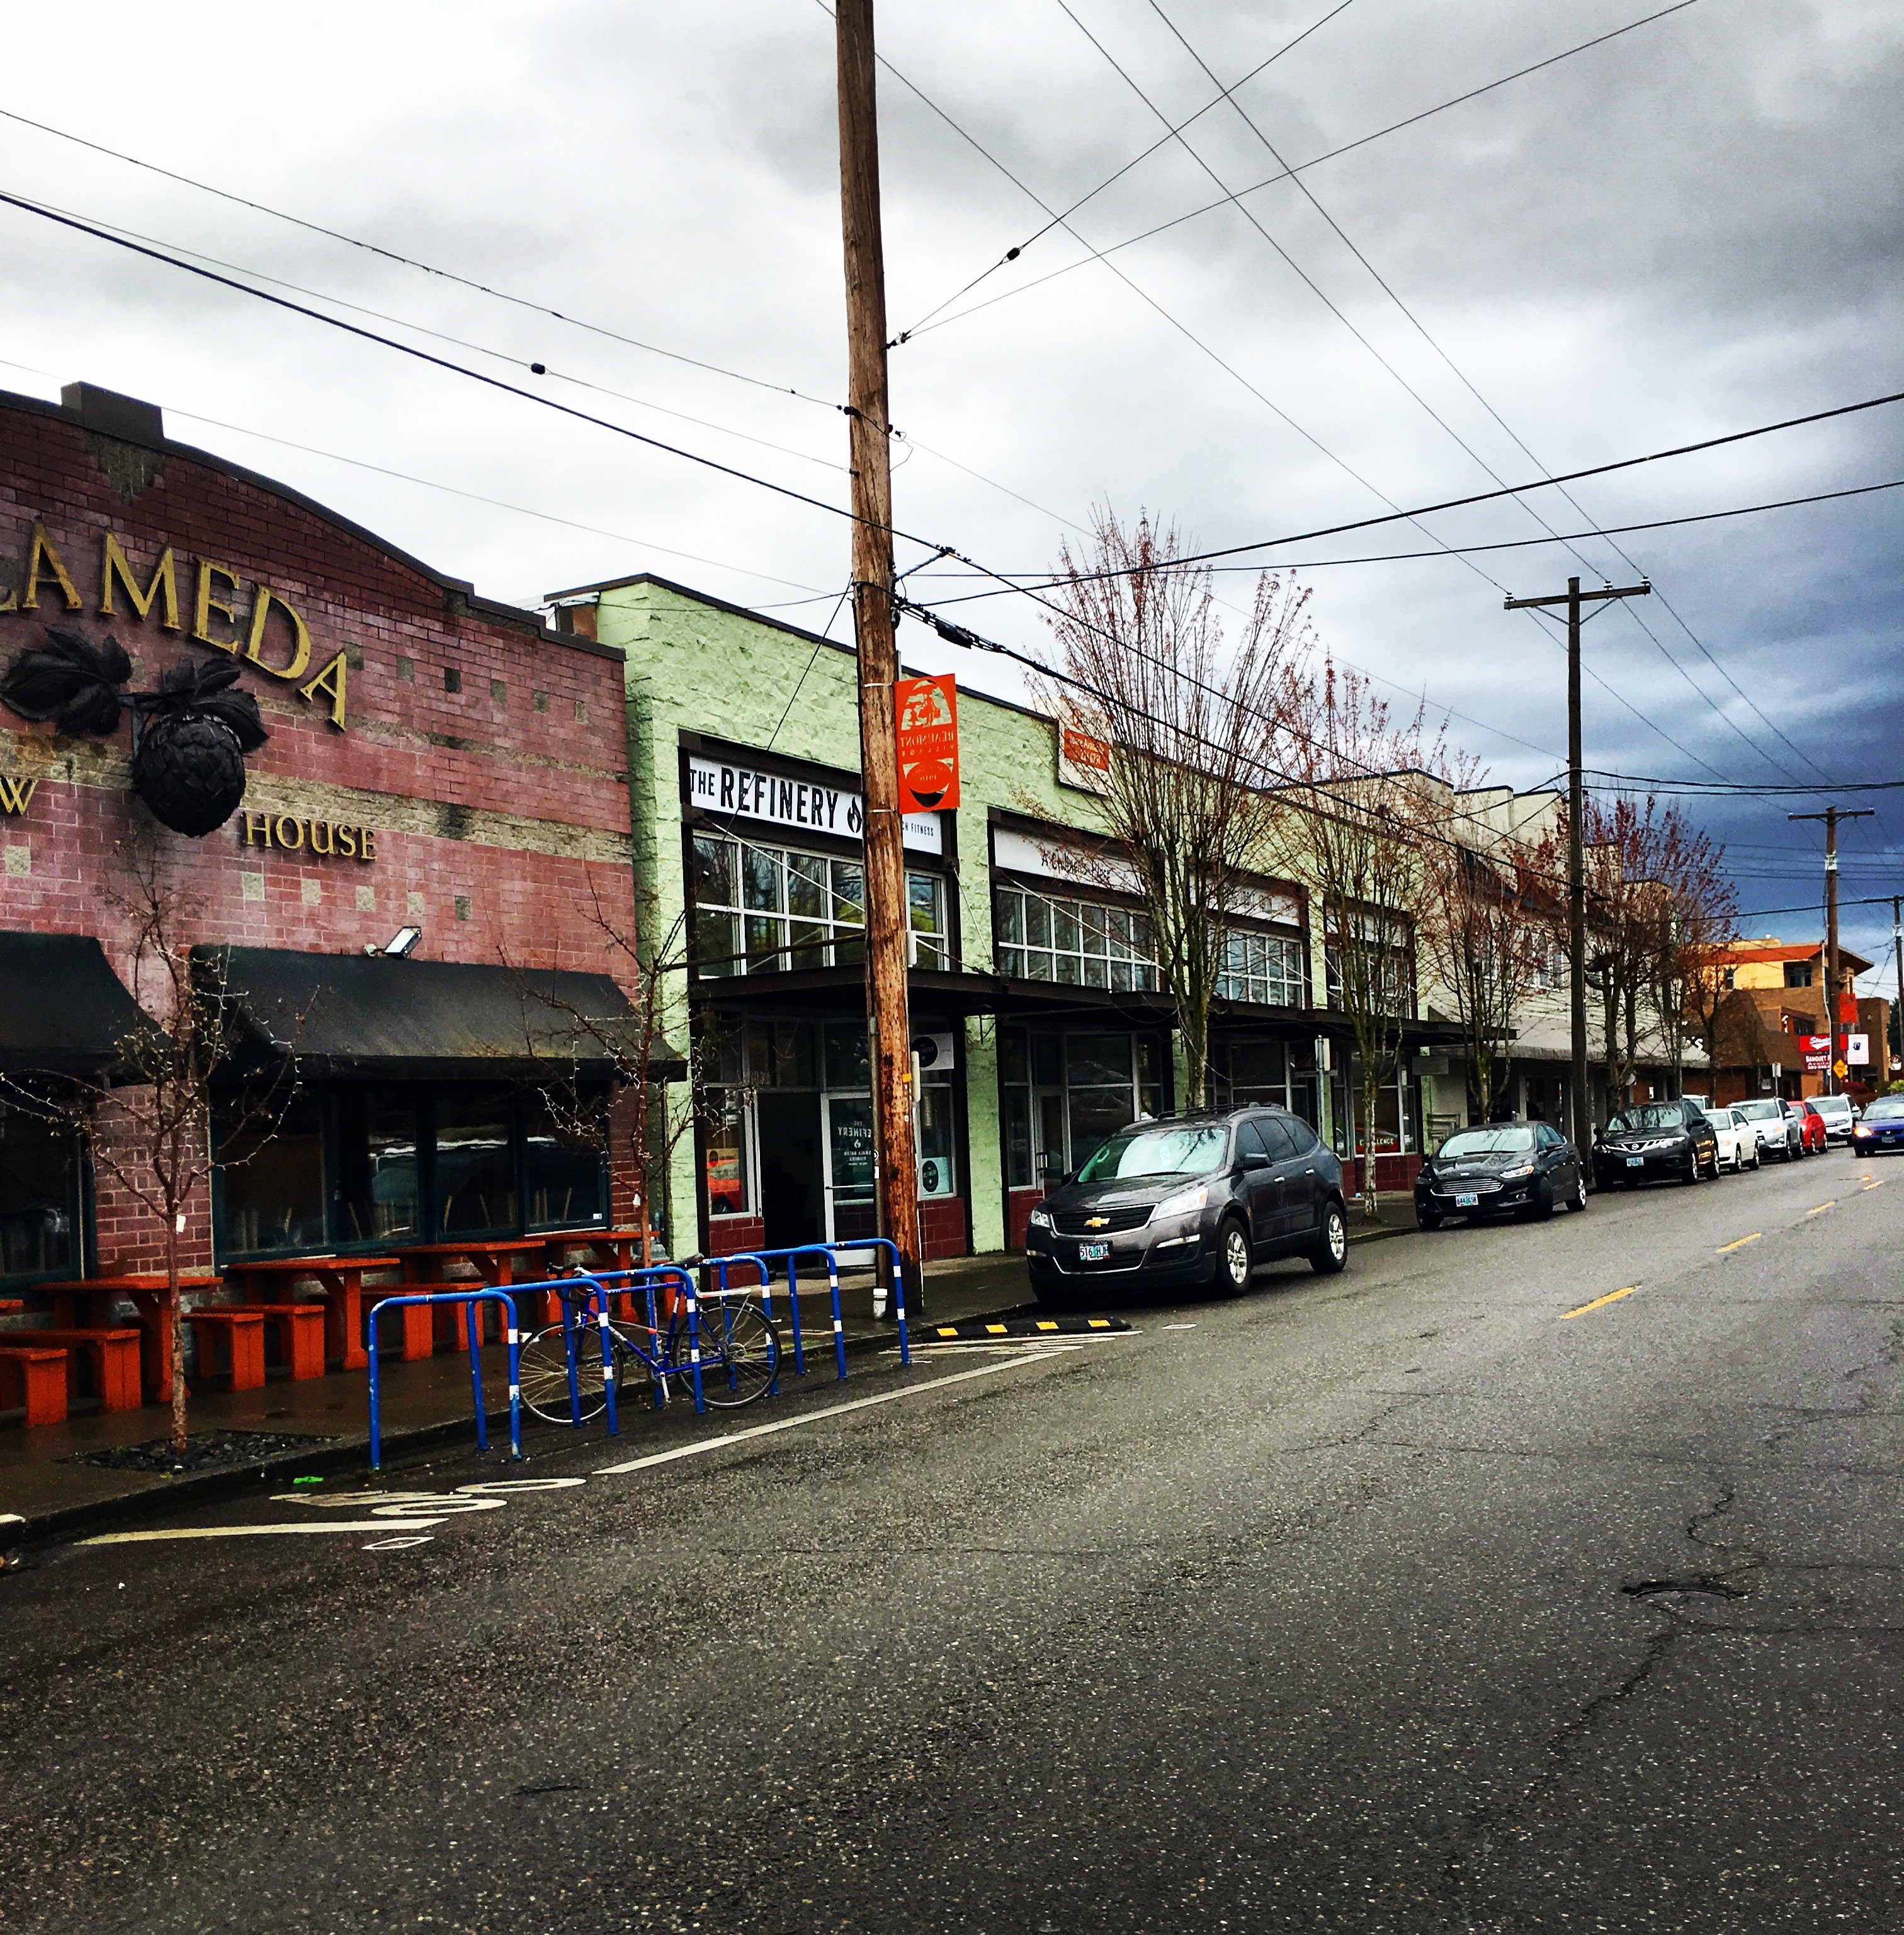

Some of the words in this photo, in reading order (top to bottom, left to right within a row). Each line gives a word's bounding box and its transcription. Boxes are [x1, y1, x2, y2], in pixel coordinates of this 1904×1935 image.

[0, 522, 348, 731] AMEDA
[690, 769, 715, 796] THE
[720, 767, 839, 829] REFINERY
[246, 812, 378, 862] HOUSE
[911, 823, 934, 837] FITNESS
[1080, 1247, 1093, 1257] 516
